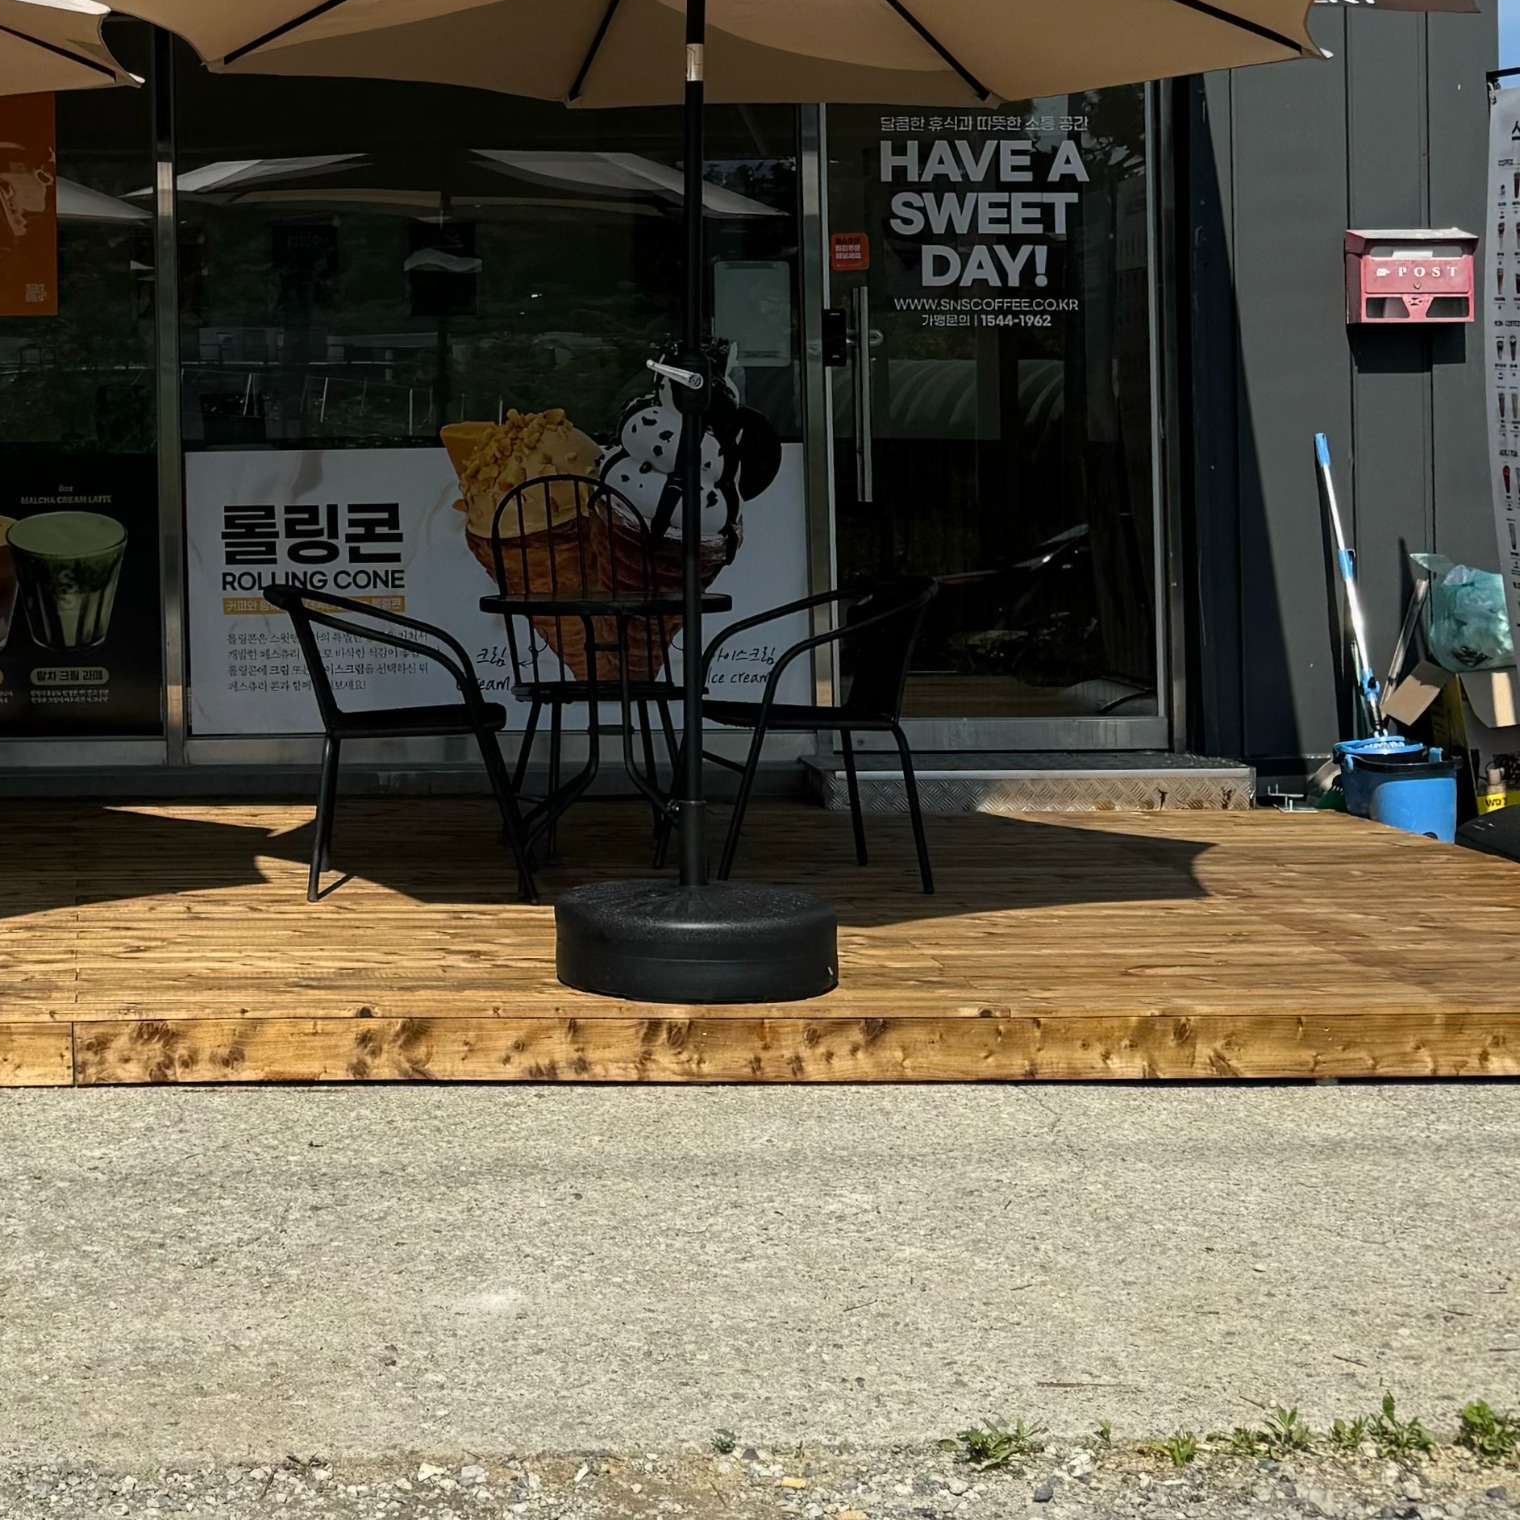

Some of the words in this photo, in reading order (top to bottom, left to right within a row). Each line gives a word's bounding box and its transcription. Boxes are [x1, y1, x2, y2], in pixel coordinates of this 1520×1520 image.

[880, 116, 925, 132] 달콤한
[928, 116, 973, 132] 휴식과
[976, 116, 1021, 132] 따뜻한
[1059, 116, 1089, 132] 공간
[880, 140, 1033, 182] HAVE
[1046, 140, 1090, 182] A
[889, 191, 1079, 235] SWEET
[921, 245, 1048, 287] DAY!
[1398, 266, 1458, 277] POST
[894, 298, 1079, 311] WWW.SNSCOFFEE.CO.KR
[921, 314, 971, 327] 가맹문의
[981, 314, 1052, 327] 1544-1962
[221, 502, 403, 566] 롤링콘
[334, 569, 405, 589] CONE
